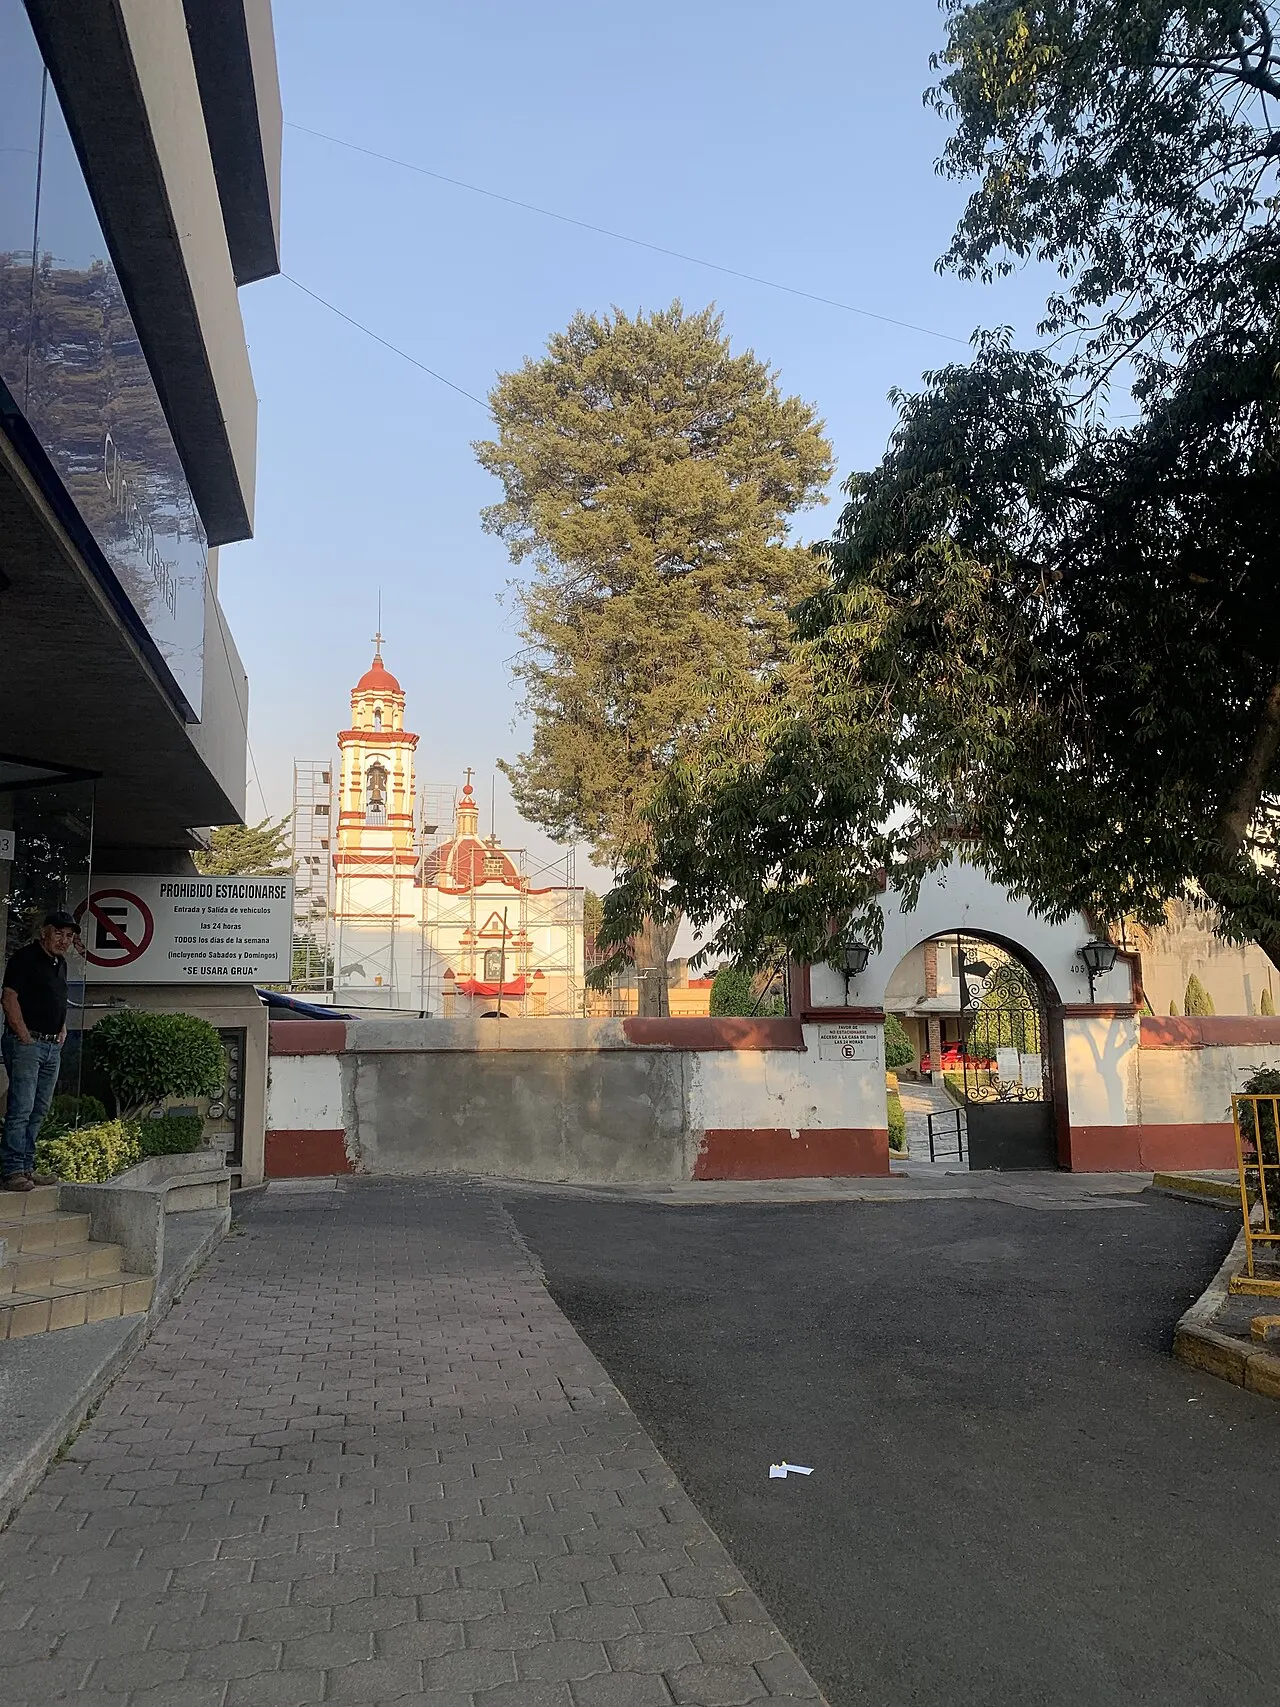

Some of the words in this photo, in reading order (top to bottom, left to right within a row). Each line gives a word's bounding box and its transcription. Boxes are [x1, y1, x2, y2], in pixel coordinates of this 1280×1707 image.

[160, 883, 213, 898] PROHIBIDO
[215, 884, 287, 899] ESTACIONARSE
[173, 905, 200, 913] Entrada
[207, 905, 229, 913] Salida
[229, 906, 239, 914] de
[200, 922, 211, 930] las
[212, 922, 221, 930] 24
[222, 922, 242, 930] horas
[174, 936, 197, 944] TODOS
[198, 936, 209, 944] los
[225, 936, 235, 944] de
[235, 936, 243, 944] la
[208, 951, 237, 959] Sabados
[238, 952, 242, 960] y
[243, 951, 278, 960] Domingos)
[200, 966, 228, 975] USARA
